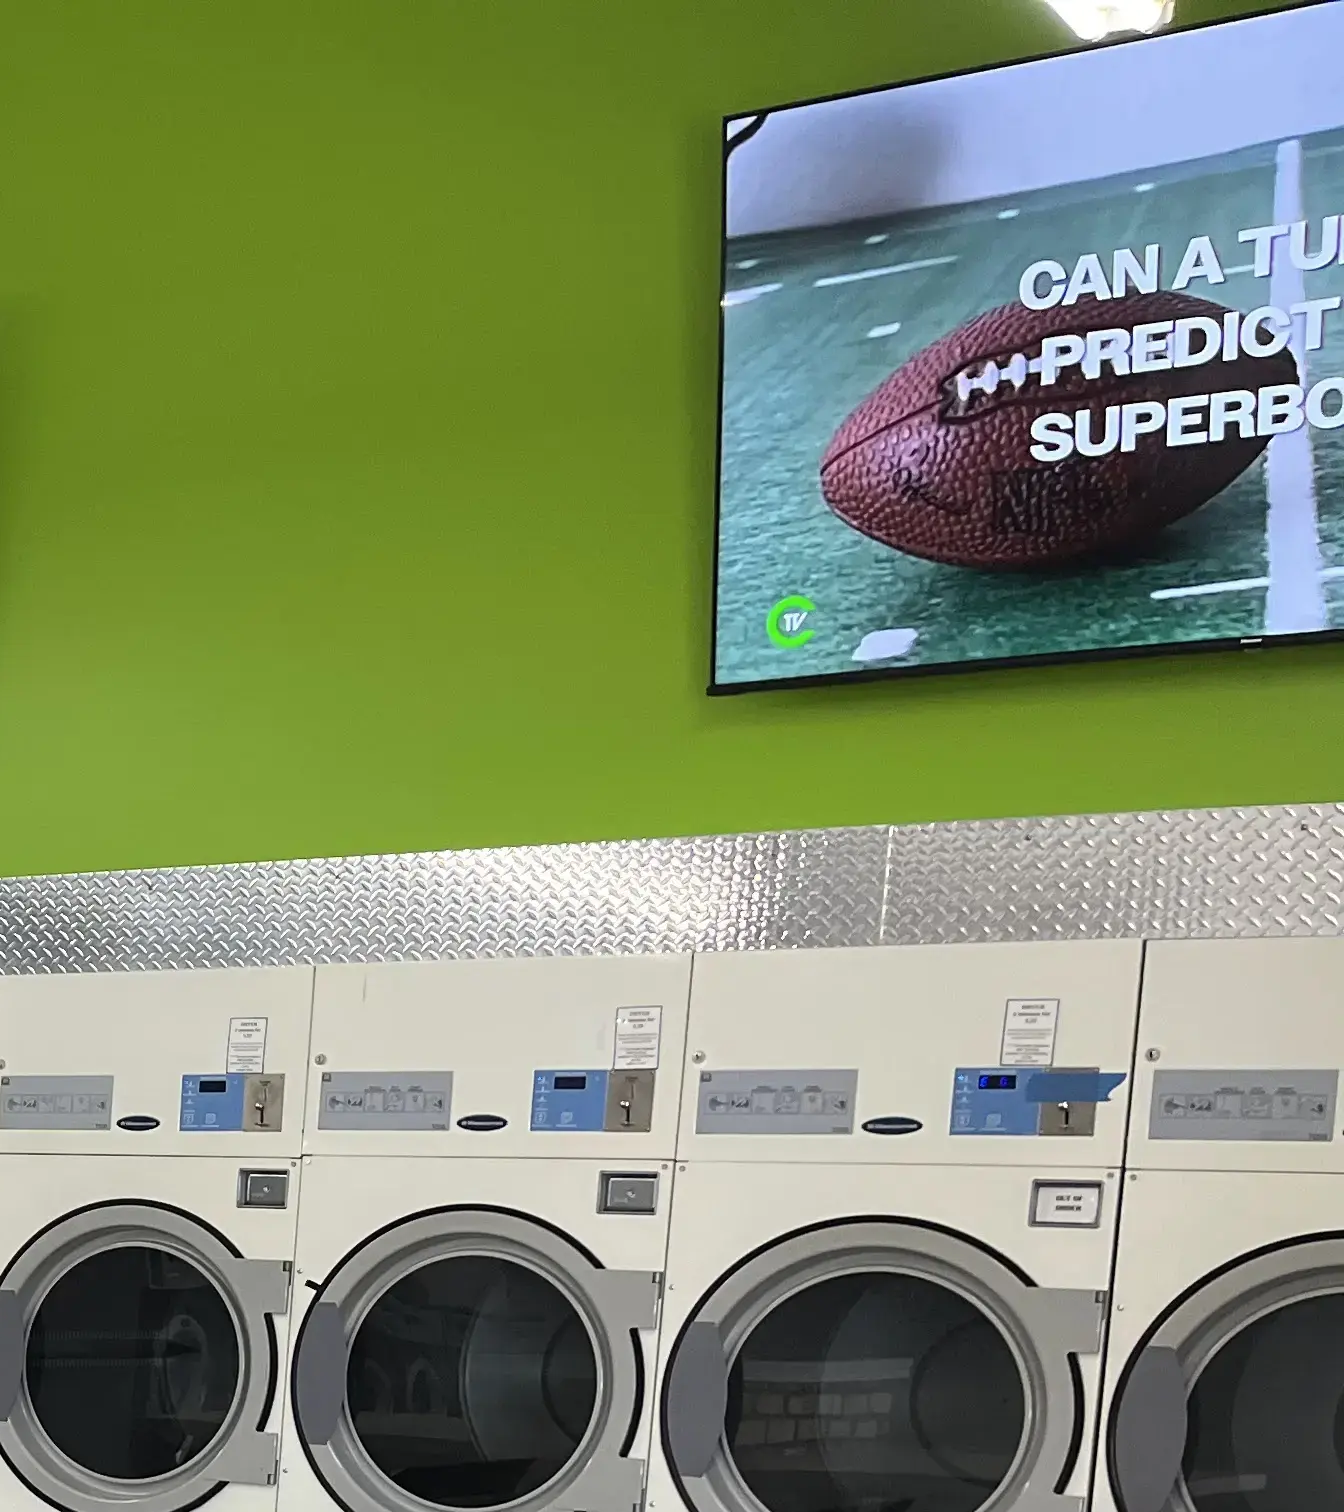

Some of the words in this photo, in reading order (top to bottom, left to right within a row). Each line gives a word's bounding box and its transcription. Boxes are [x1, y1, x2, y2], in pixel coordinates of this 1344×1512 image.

[1019, 243, 1159, 311] CAN
[1171, 235, 1224, 291] A
[1238, 214, 1344, 277] TU
[1040, 296, 1341, 386] PREDICT
[1029, 376, 1344, 462] SUPERBO
